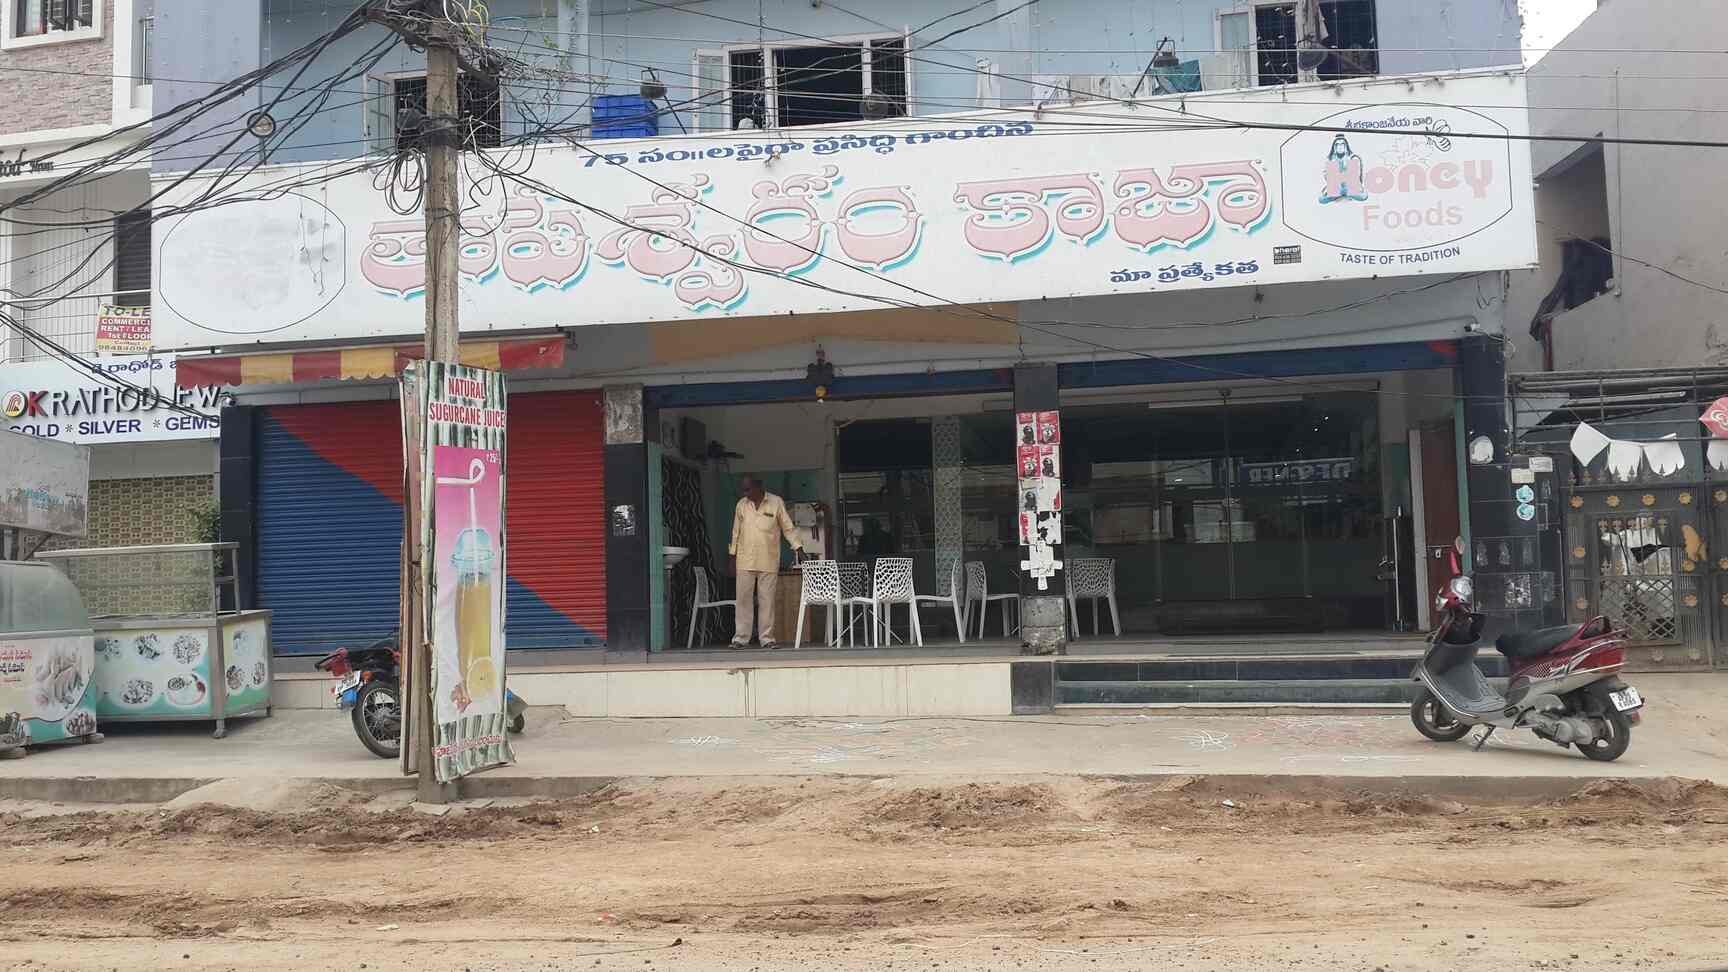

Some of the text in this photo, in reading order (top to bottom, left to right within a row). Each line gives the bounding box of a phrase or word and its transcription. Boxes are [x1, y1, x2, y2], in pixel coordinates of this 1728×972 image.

[578, 153, 629, 168] 75
[1325, 160, 1494, 200] Honey
[952, 159, 1272, 264] కాజా
[1363, 200, 1463, 231] Foods
[1340, 247, 1461, 265] TASTE OF TRADITION
[1110, 268, 1151, 284] మా
[447, 378, 485, 399] NATURAL
[78, 420, 141, 435] SILVER
[165, 415, 220, 431] GEMS
[429, 402, 505, 428] SUGURCANE JUICE
